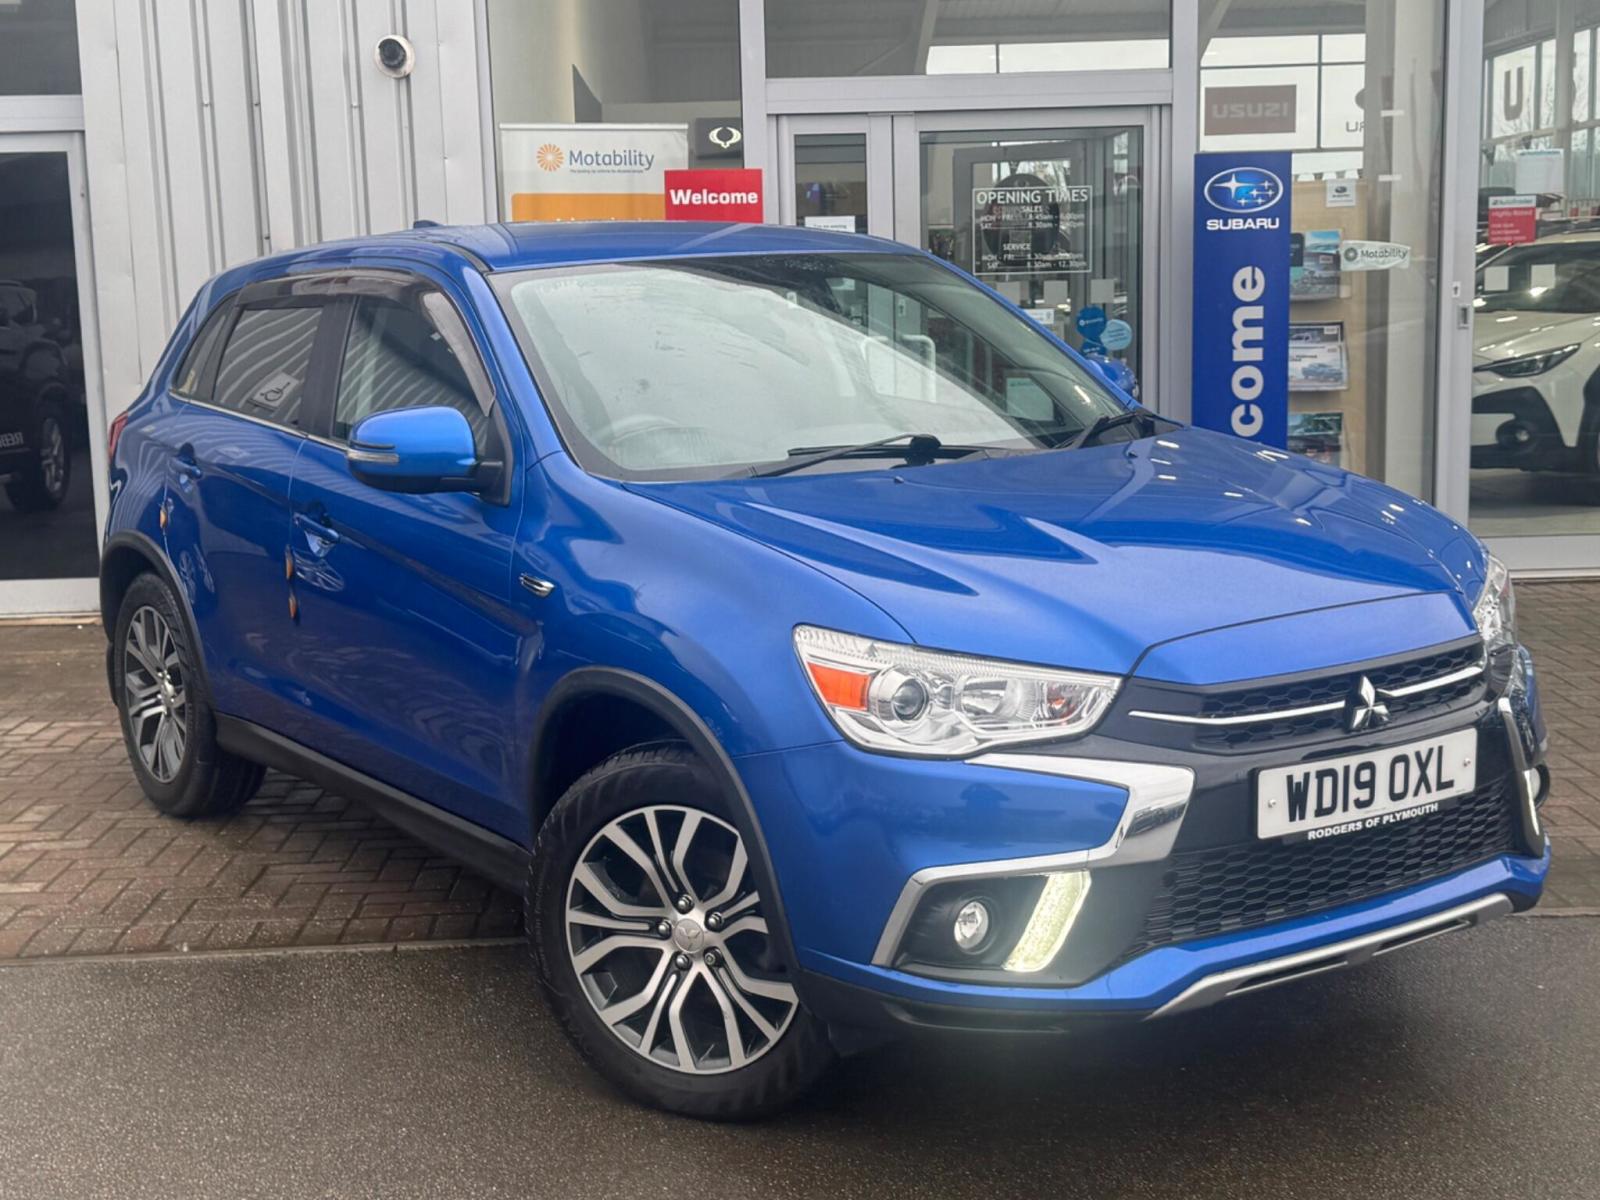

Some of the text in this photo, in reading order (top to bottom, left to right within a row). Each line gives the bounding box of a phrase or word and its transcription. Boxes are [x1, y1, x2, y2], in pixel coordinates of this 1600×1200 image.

[569, 149, 655, 171] Motability
[669, 188, 759, 205] Welcome
[976, 188, 1089, 204] OPENING TIMES
[1206, 217, 1280, 231] SUBARU
[1003, 243, 1031, 251] SERVICE
[1360, 247, 1409, 260] Motability
[1286, 745, 1454, 822] WD19 OXL
[1308, 802, 1439, 840] RODGERS OF PLYMOUTH
